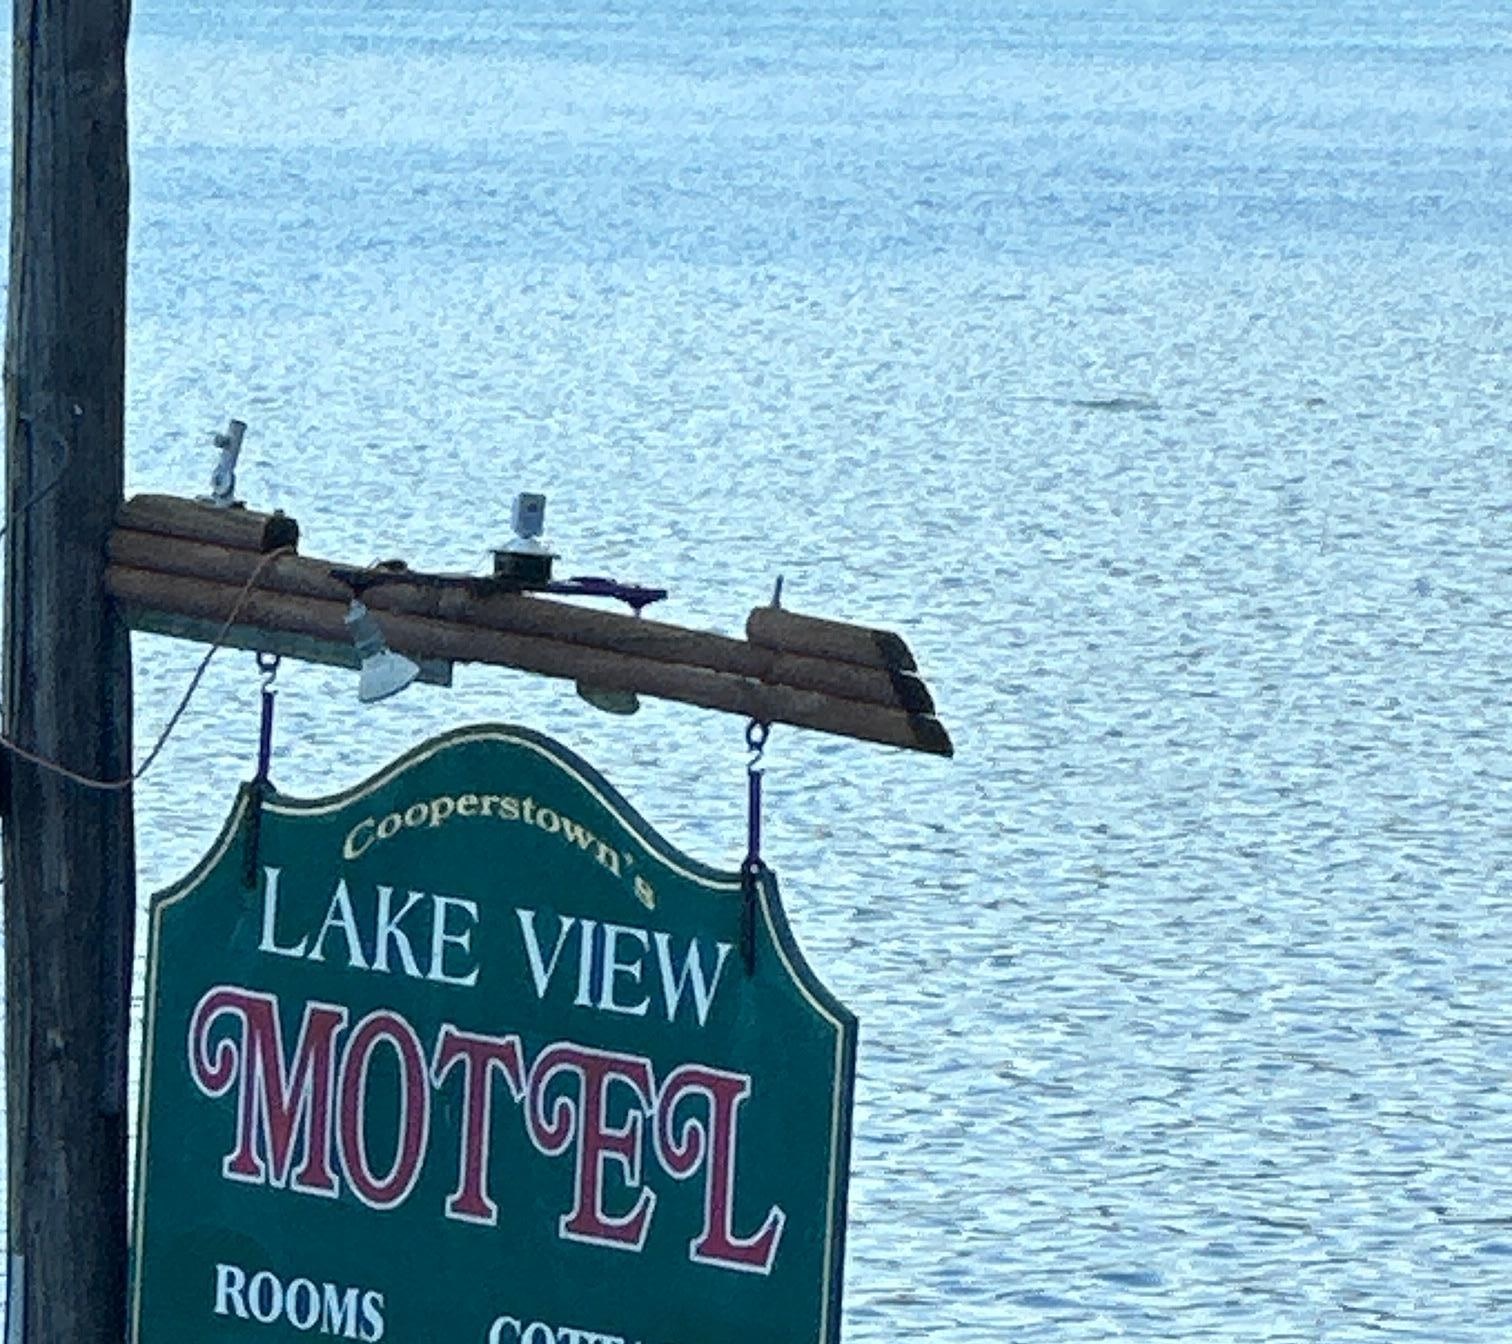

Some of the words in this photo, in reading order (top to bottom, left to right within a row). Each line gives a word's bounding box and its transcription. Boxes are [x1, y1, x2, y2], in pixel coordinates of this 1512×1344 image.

[342, 793, 657, 912] Cooperstown's
[257, 865, 481, 987] LAKE
[515, 907, 733, 1028] VIEW
[188, 985, 787, 1276] MOTEL
[214, 1263, 385, 1344] ROOMS
